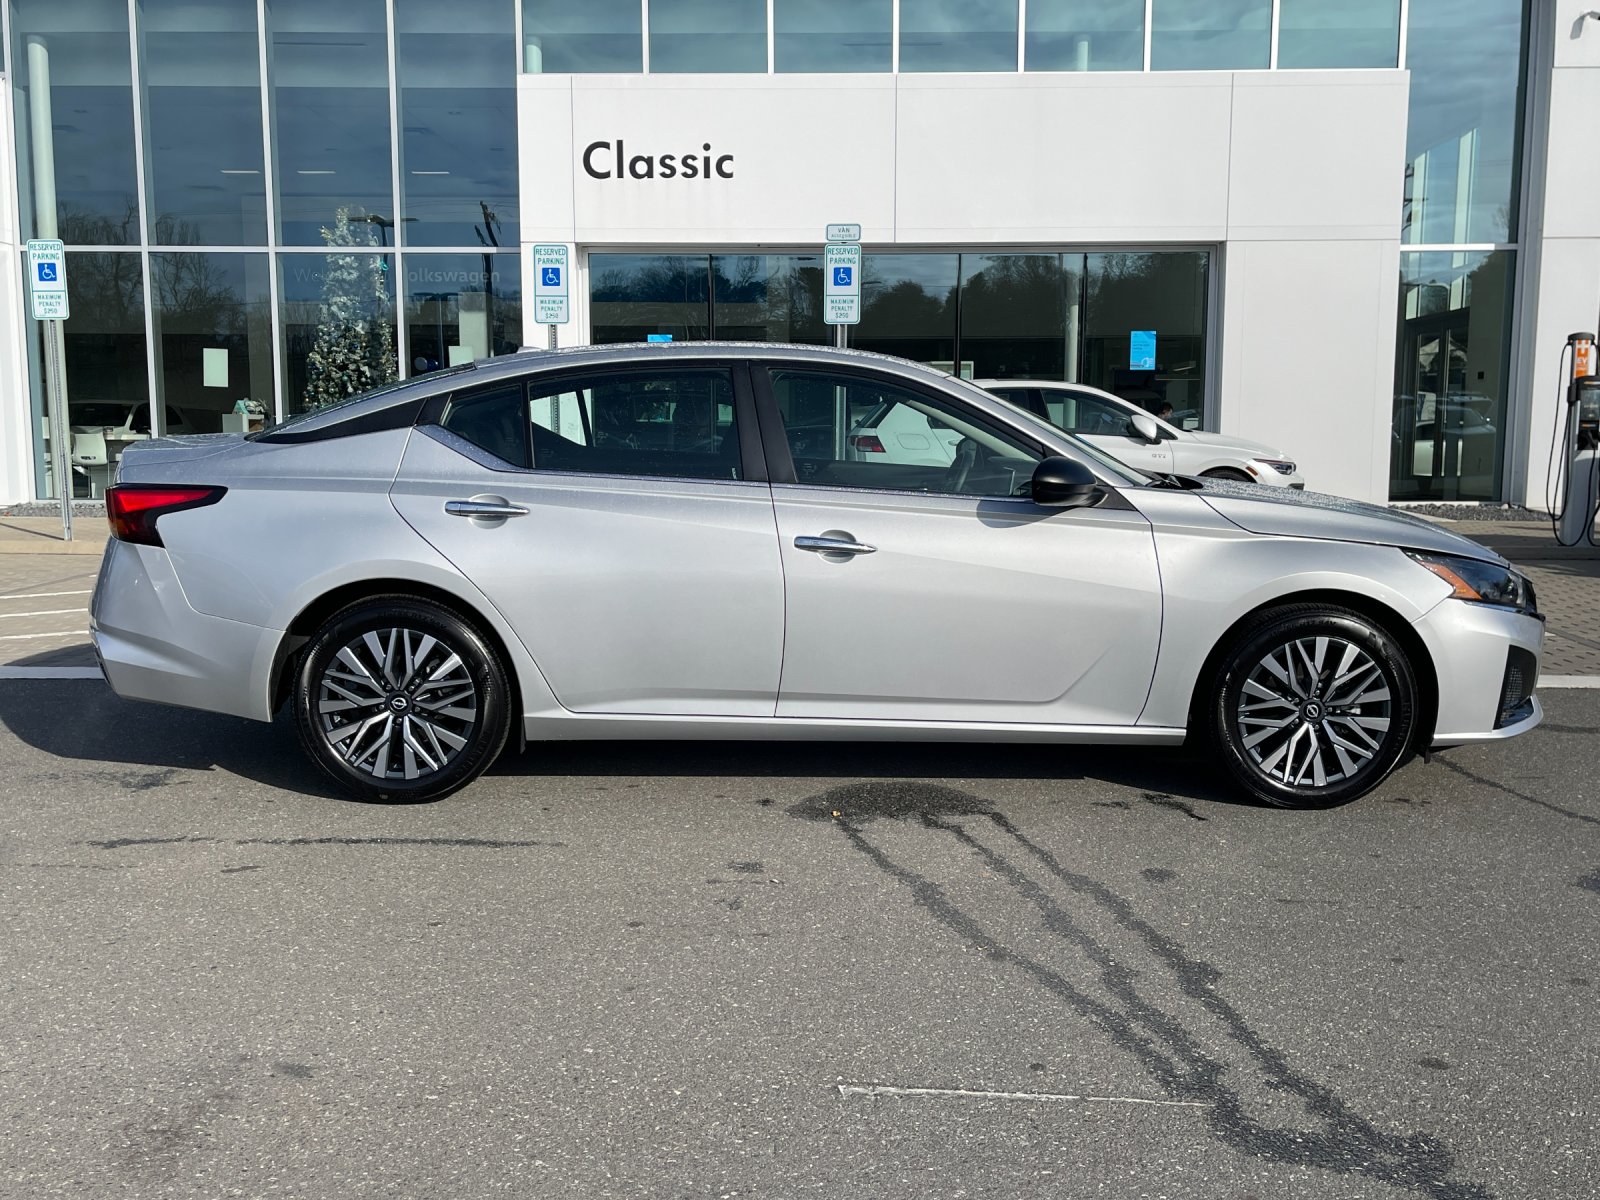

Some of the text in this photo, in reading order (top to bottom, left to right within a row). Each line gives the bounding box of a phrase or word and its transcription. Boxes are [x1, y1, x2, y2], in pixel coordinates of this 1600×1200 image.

[582, 139, 734, 180] Classic
[30, 243, 61, 251] RESERVED
[827, 247, 859, 255] RESERVED
[535, 248, 566, 256] RESERVED
[537, 257, 565, 265] PARKING
[829, 257, 856, 265] PARKING
[400, 267, 500, 286] olkswagen
